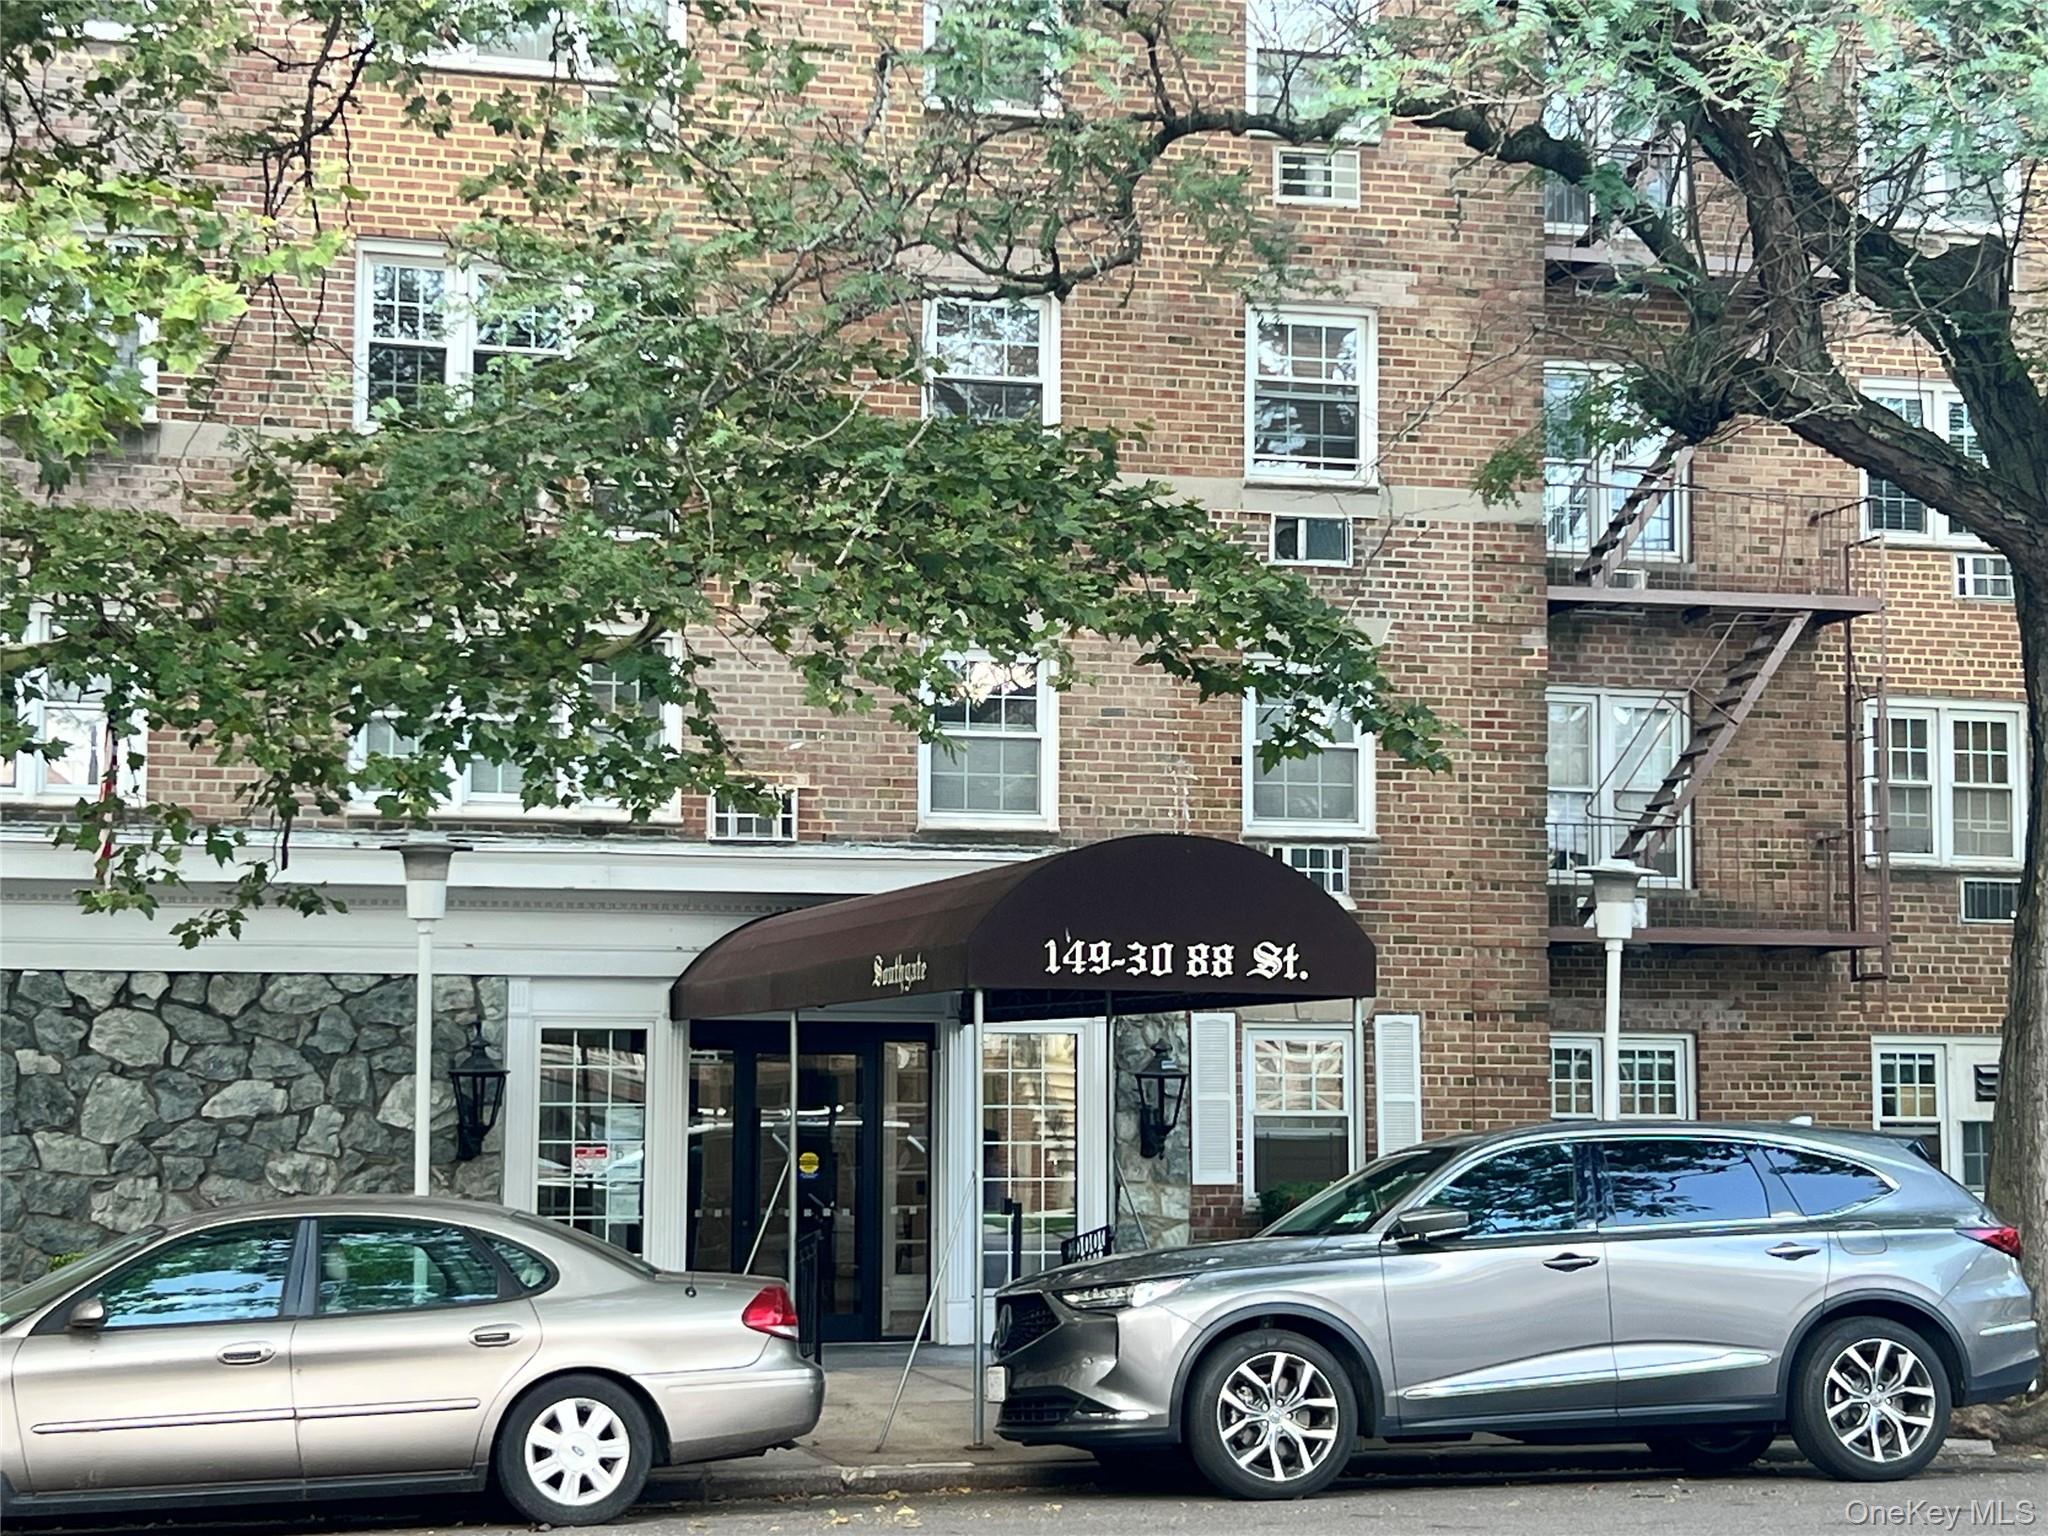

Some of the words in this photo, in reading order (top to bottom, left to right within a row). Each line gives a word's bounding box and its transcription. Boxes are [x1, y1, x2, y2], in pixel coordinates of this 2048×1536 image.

[872, 952, 927, 994] Southgate
[1044, 939, 1174, 976] 149-30
[1186, 943, 1235, 977] 88
[1246, 941, 1309, 980] St.
